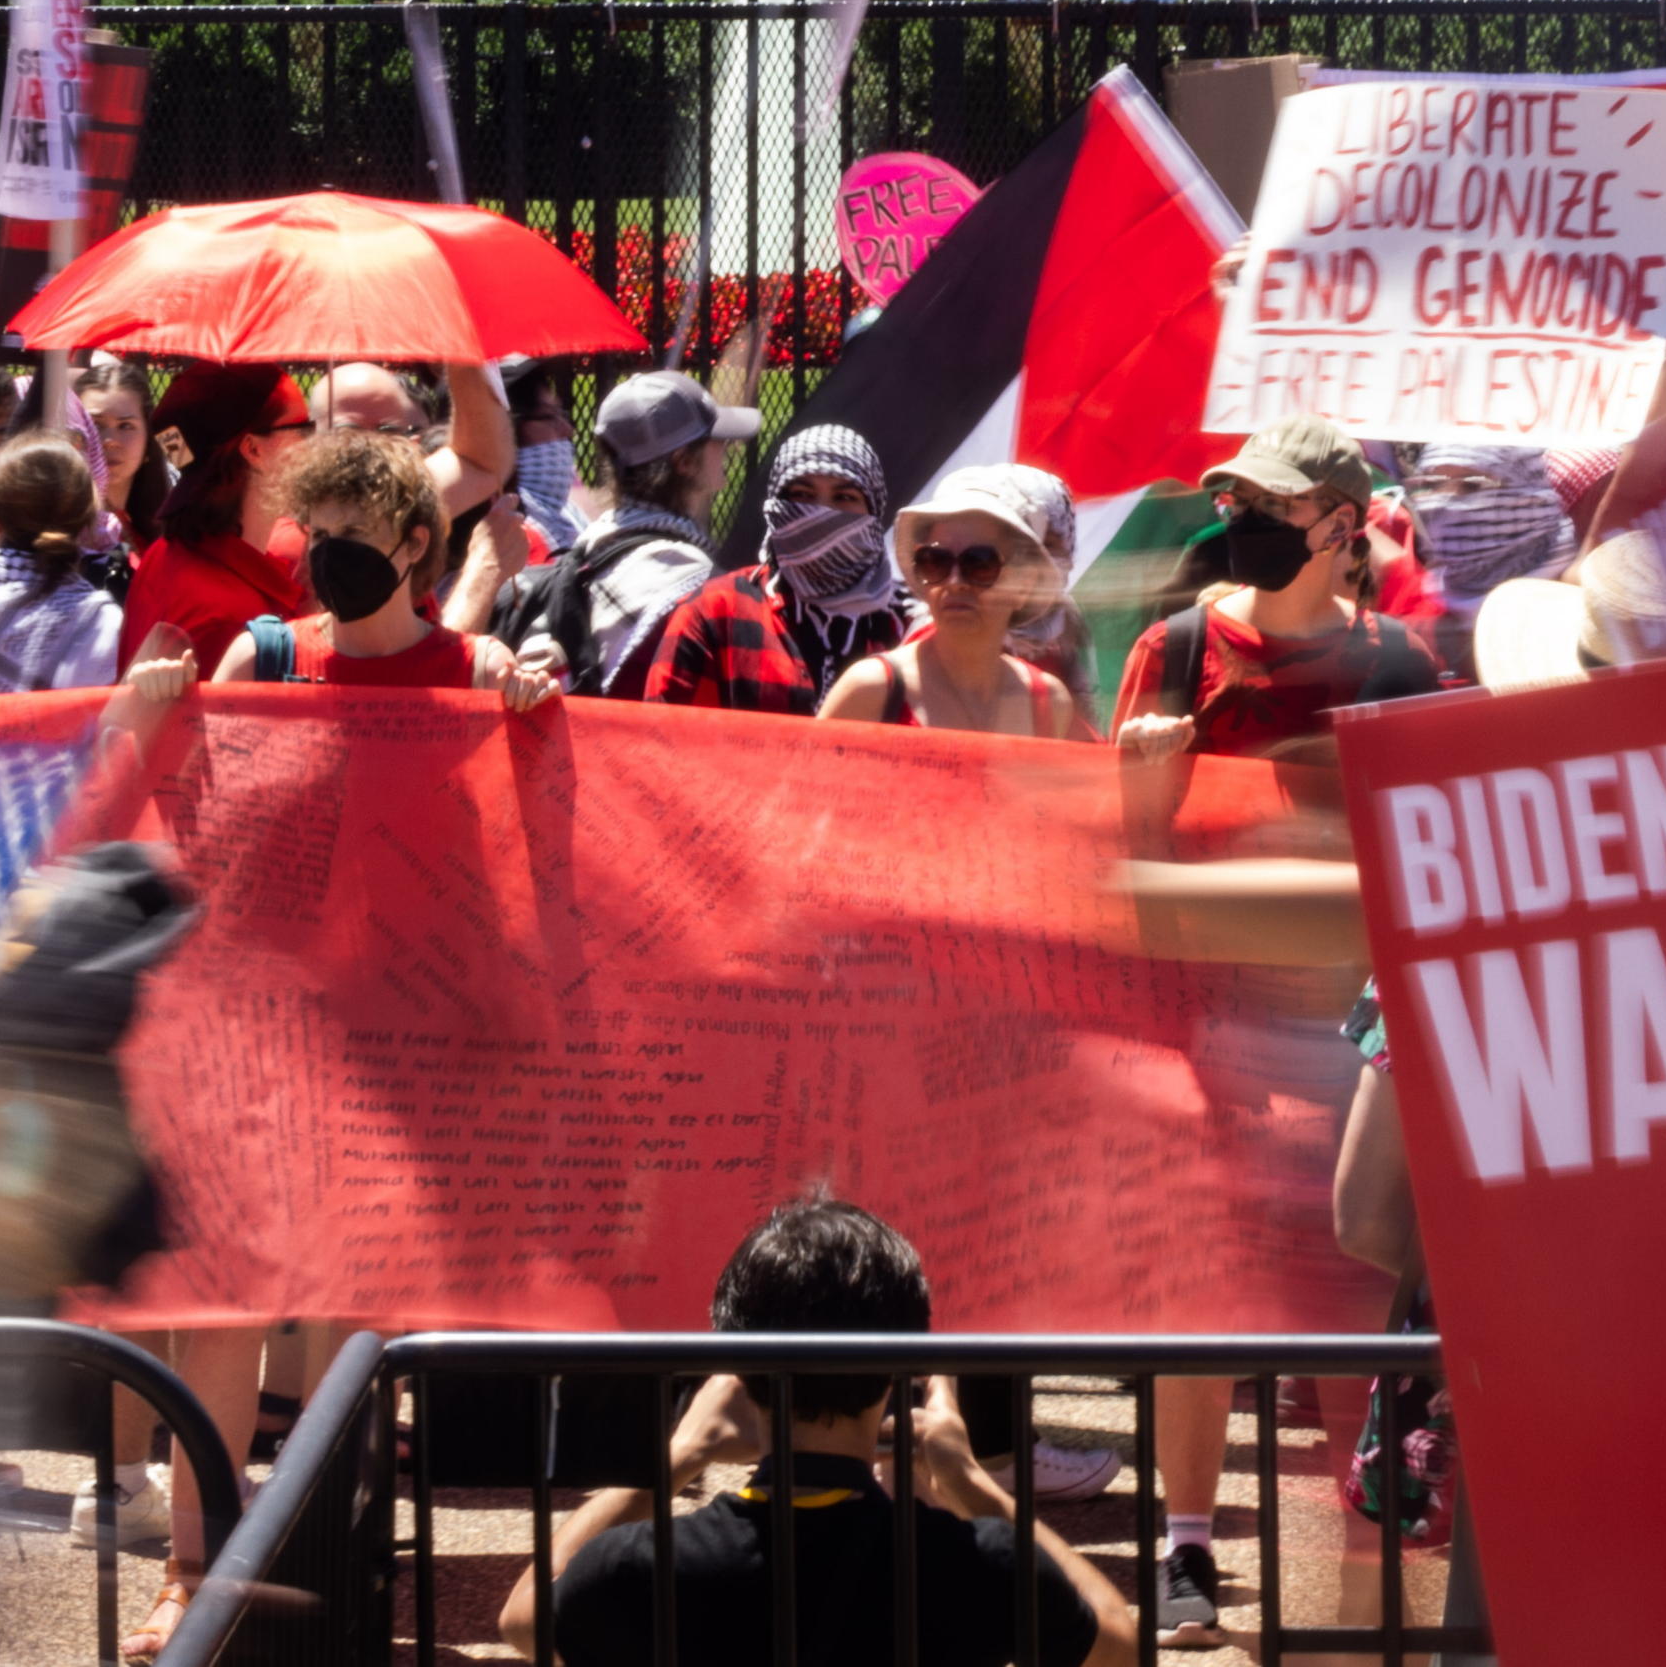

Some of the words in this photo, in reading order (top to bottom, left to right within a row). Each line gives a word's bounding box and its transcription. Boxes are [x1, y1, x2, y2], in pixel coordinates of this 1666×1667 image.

[1335, 85, 1579, 159] LIBERATE
[843, 173, 964, 233] FREE
[1305, 162, 1620, 240] DECOLONIZE
[1252, 247, 1378, 323] END
[1248, 348, 1371, 427] FREE
[1391, 348, 1652, 432] PALESTINE
